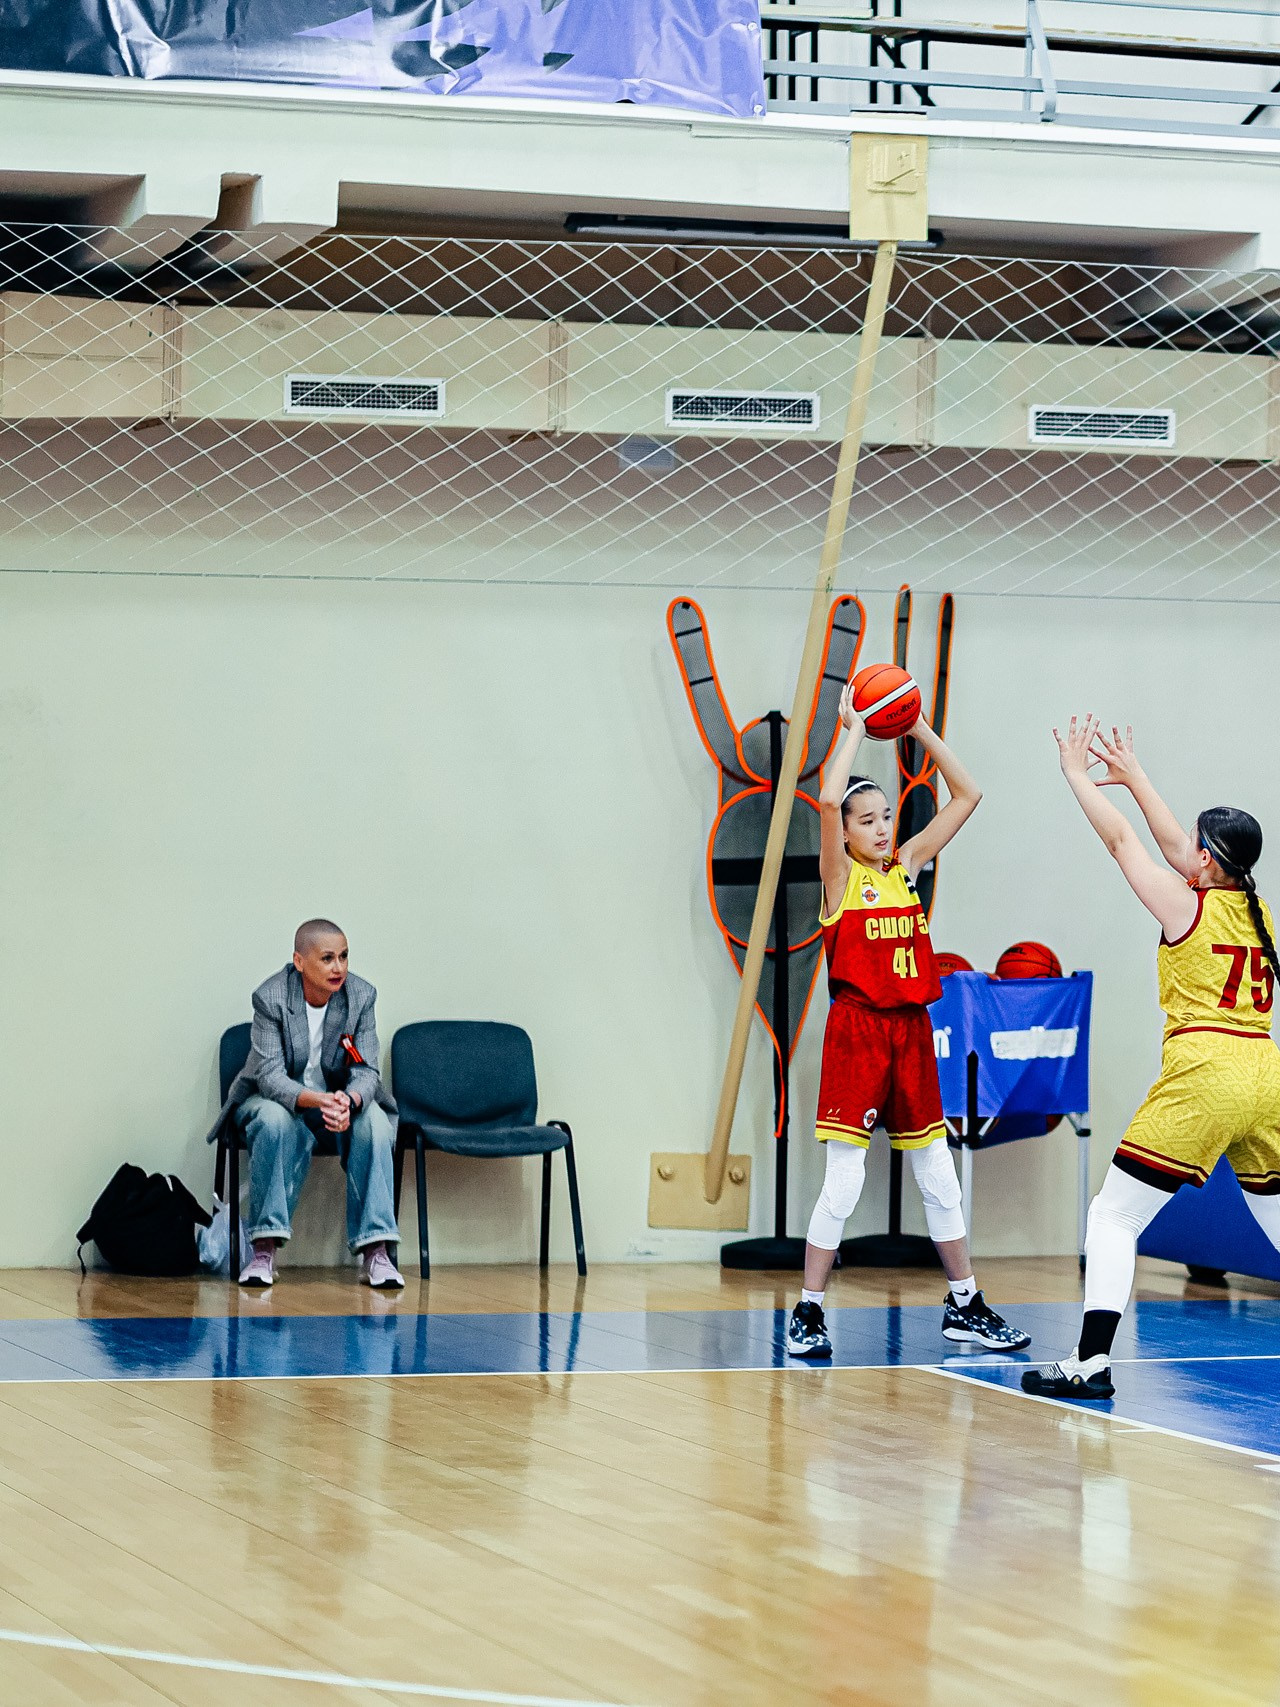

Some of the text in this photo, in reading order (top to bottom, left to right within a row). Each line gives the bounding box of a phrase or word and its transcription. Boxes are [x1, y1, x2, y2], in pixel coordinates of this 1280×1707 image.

[886, 697, 917, 721] molten
[893, 946, 919, 979] 41
[1211, 943, 1275, 1014] 75
